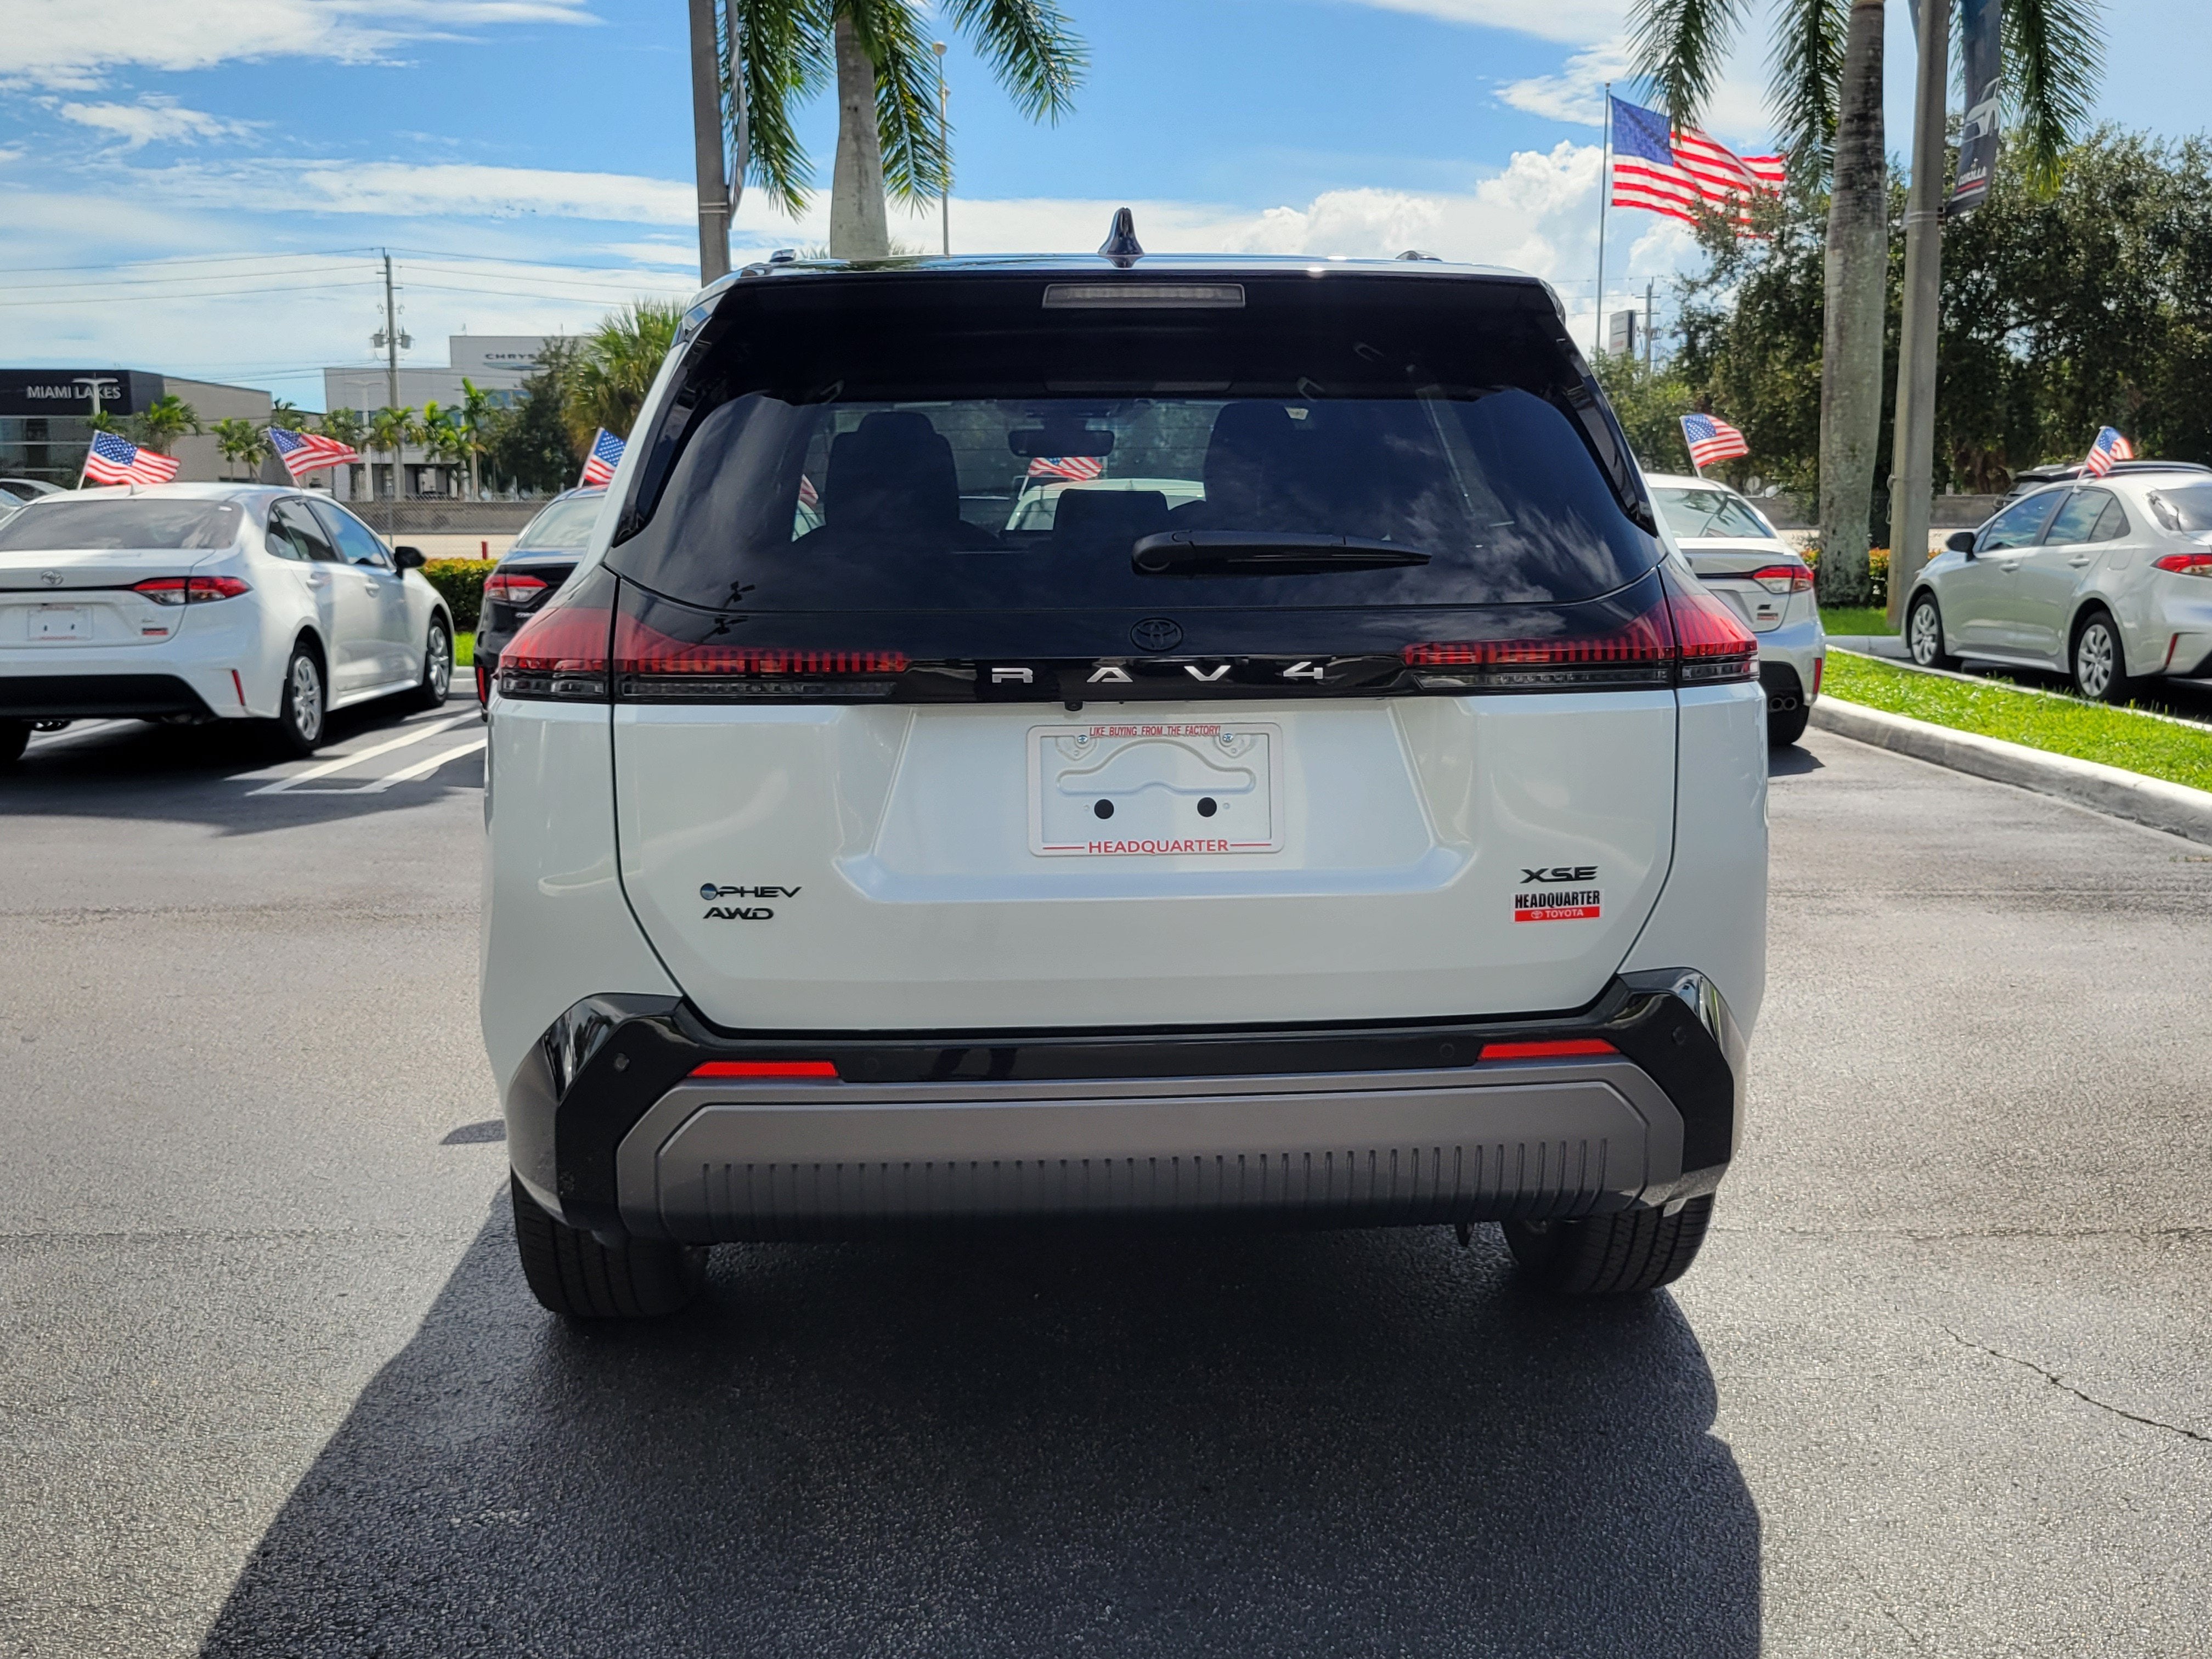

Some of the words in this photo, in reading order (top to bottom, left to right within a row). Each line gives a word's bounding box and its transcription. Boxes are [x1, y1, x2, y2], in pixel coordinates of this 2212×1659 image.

[27, 385, 72, 399] MIAMI
[991, 662, 1323, 683] RAV4
[1090, 727, 1105, 736] LIKE
[1109, 727, 1137, 736] BUYING
[1142, 726, 1163, 735] FROM
[1167, 726, 1181, 735] THE
[1185, 725, 1221, 735] FACTORY!
[1089, 839, 1229, 854] HEADQUARTER
[1520, 866, 1599, 884] XSE
[1515, 890, 1600, 909] HEADQUARTER
[703, 907, 775, 920] AWD
[1545, 909, 1584, 918] TOYOTA
